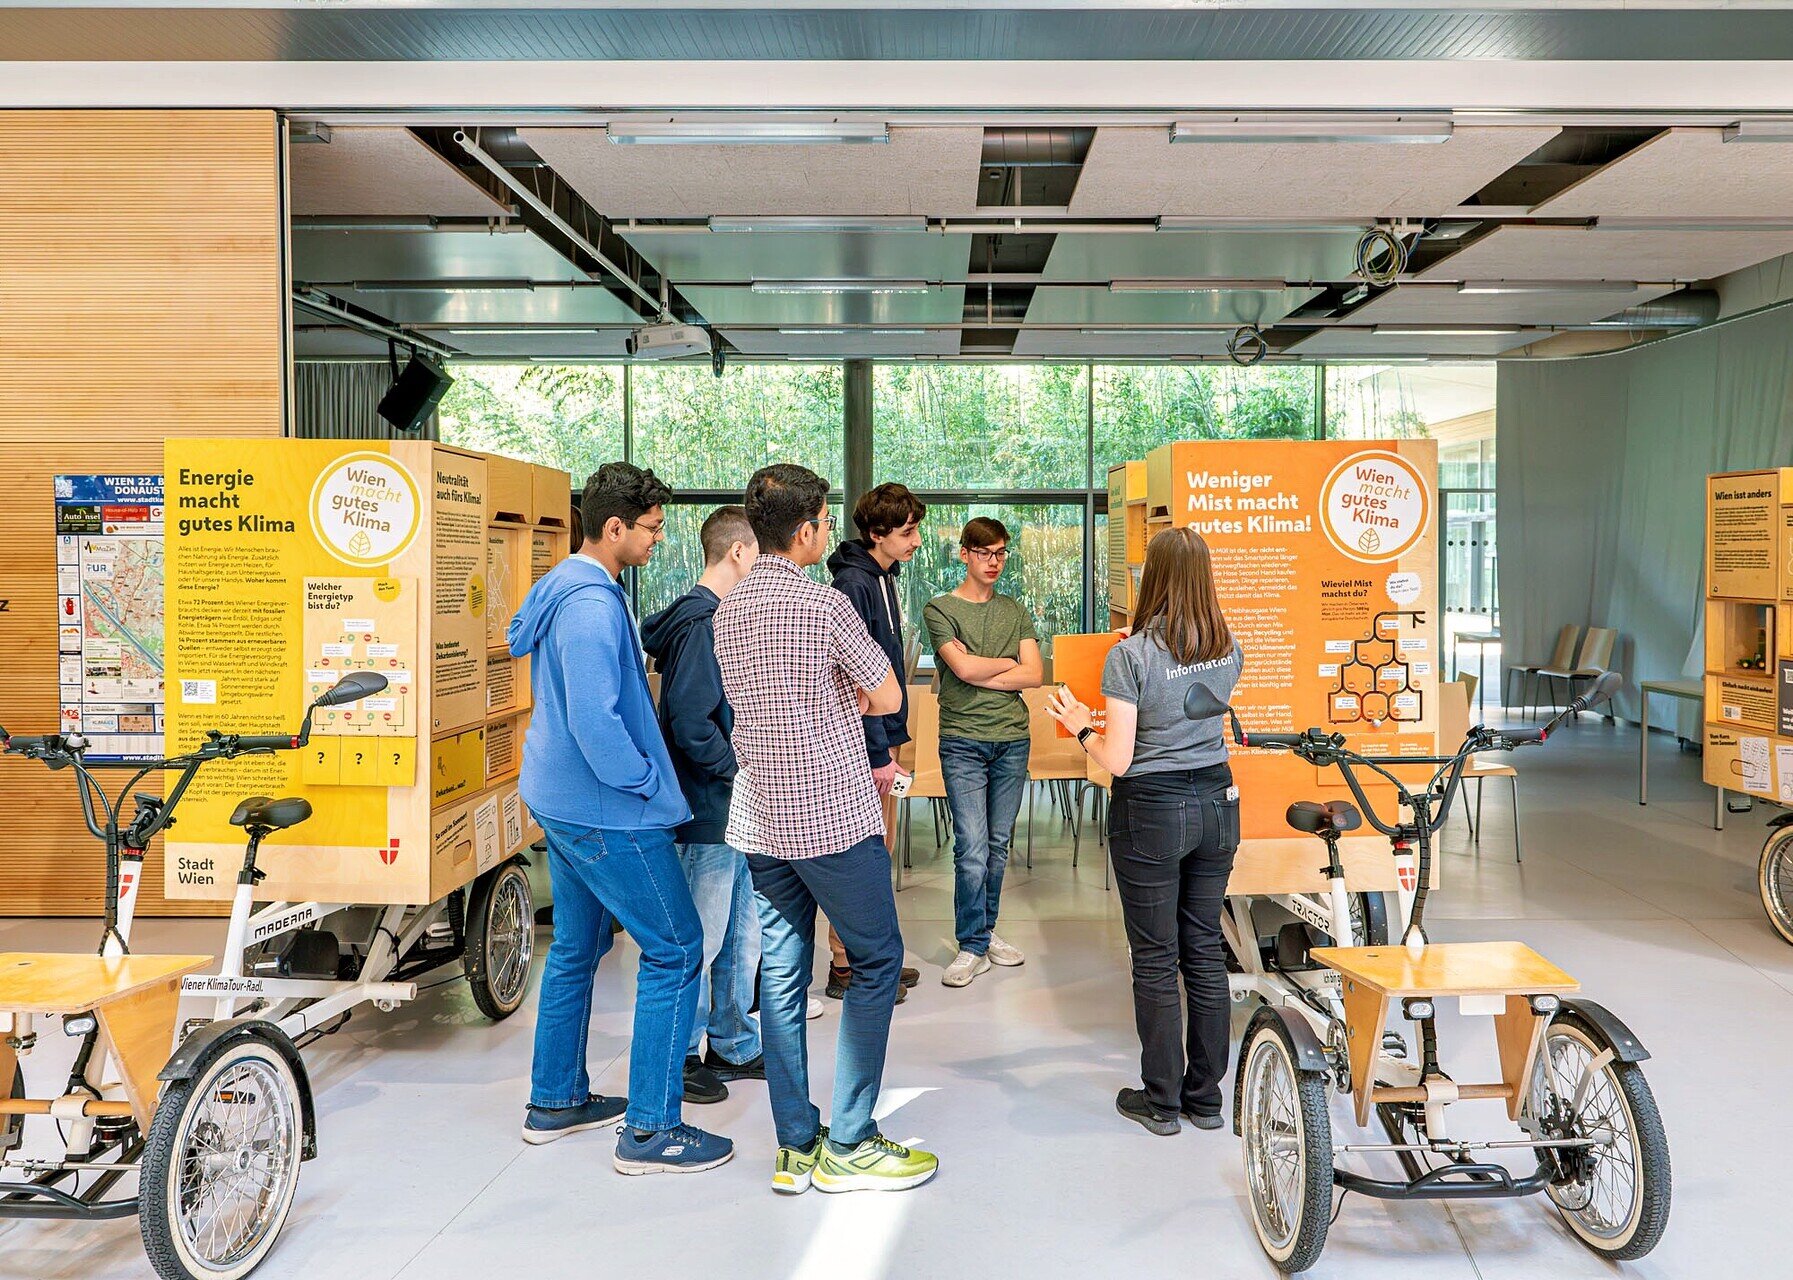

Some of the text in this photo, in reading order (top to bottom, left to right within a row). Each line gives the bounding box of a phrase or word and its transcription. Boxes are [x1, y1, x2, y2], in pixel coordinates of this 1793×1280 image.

[104, 477, 134, 486] WIEN
[137, 477, 154, 486] 22.
[179, 469, 254, 490] Energie
[347, 467, 386, 488] Wien
[436, 471, 469, 488] Neutralität
[1186, 471, 1273, 492] Weniger
[1356, 466, 1395, 486] Wien
[351, 484, 402, 504] macht
[436, 489, 481, 505] auch fürs Klima!
[1359, 482, 1412, 501] macht
[1715, 490, 1772, 500] Wien isst anders
[179, 492, 240, 509] macht
[332, 494, 379, 512] gutes
[1187, 493, 1299, 511] Mist macht
[1341, 492, 1387, 510] gutes
[178, 515, 295, 536] gutes Klima
[343, 509, 391, 533] Klima
[1187, 515, 1312, 534] gutes Klima!
[1352, 508, 1400, 529] Klima
[194, 584, 219, 592] Energie?
[307, 583, 342, 591] Welcher
[1321, 580, 1353, 588] Wieviel
[307, 592, 353, 602] Energietyp
[1321, 589, 1368, 598] machst du?
[178, 614, 222, 622] Energieträgern
[1166, 655, 1234, 680] Information
[317, 752, 325, 764] ?
[355, 753, 363, 765] ?
[393, 753, 400, 765] ?
[1251, 748, 1290, 756] Klima-Sieger.
[178, 858, 214, 870] Stadt
[178, 872, 214, 885] Wien
[254, 908, 313, 939] MADERNA
[1291, 899, 1330, 932] TRACTOR
[207, 978, 263, 992] KlimaTour-Radl.
